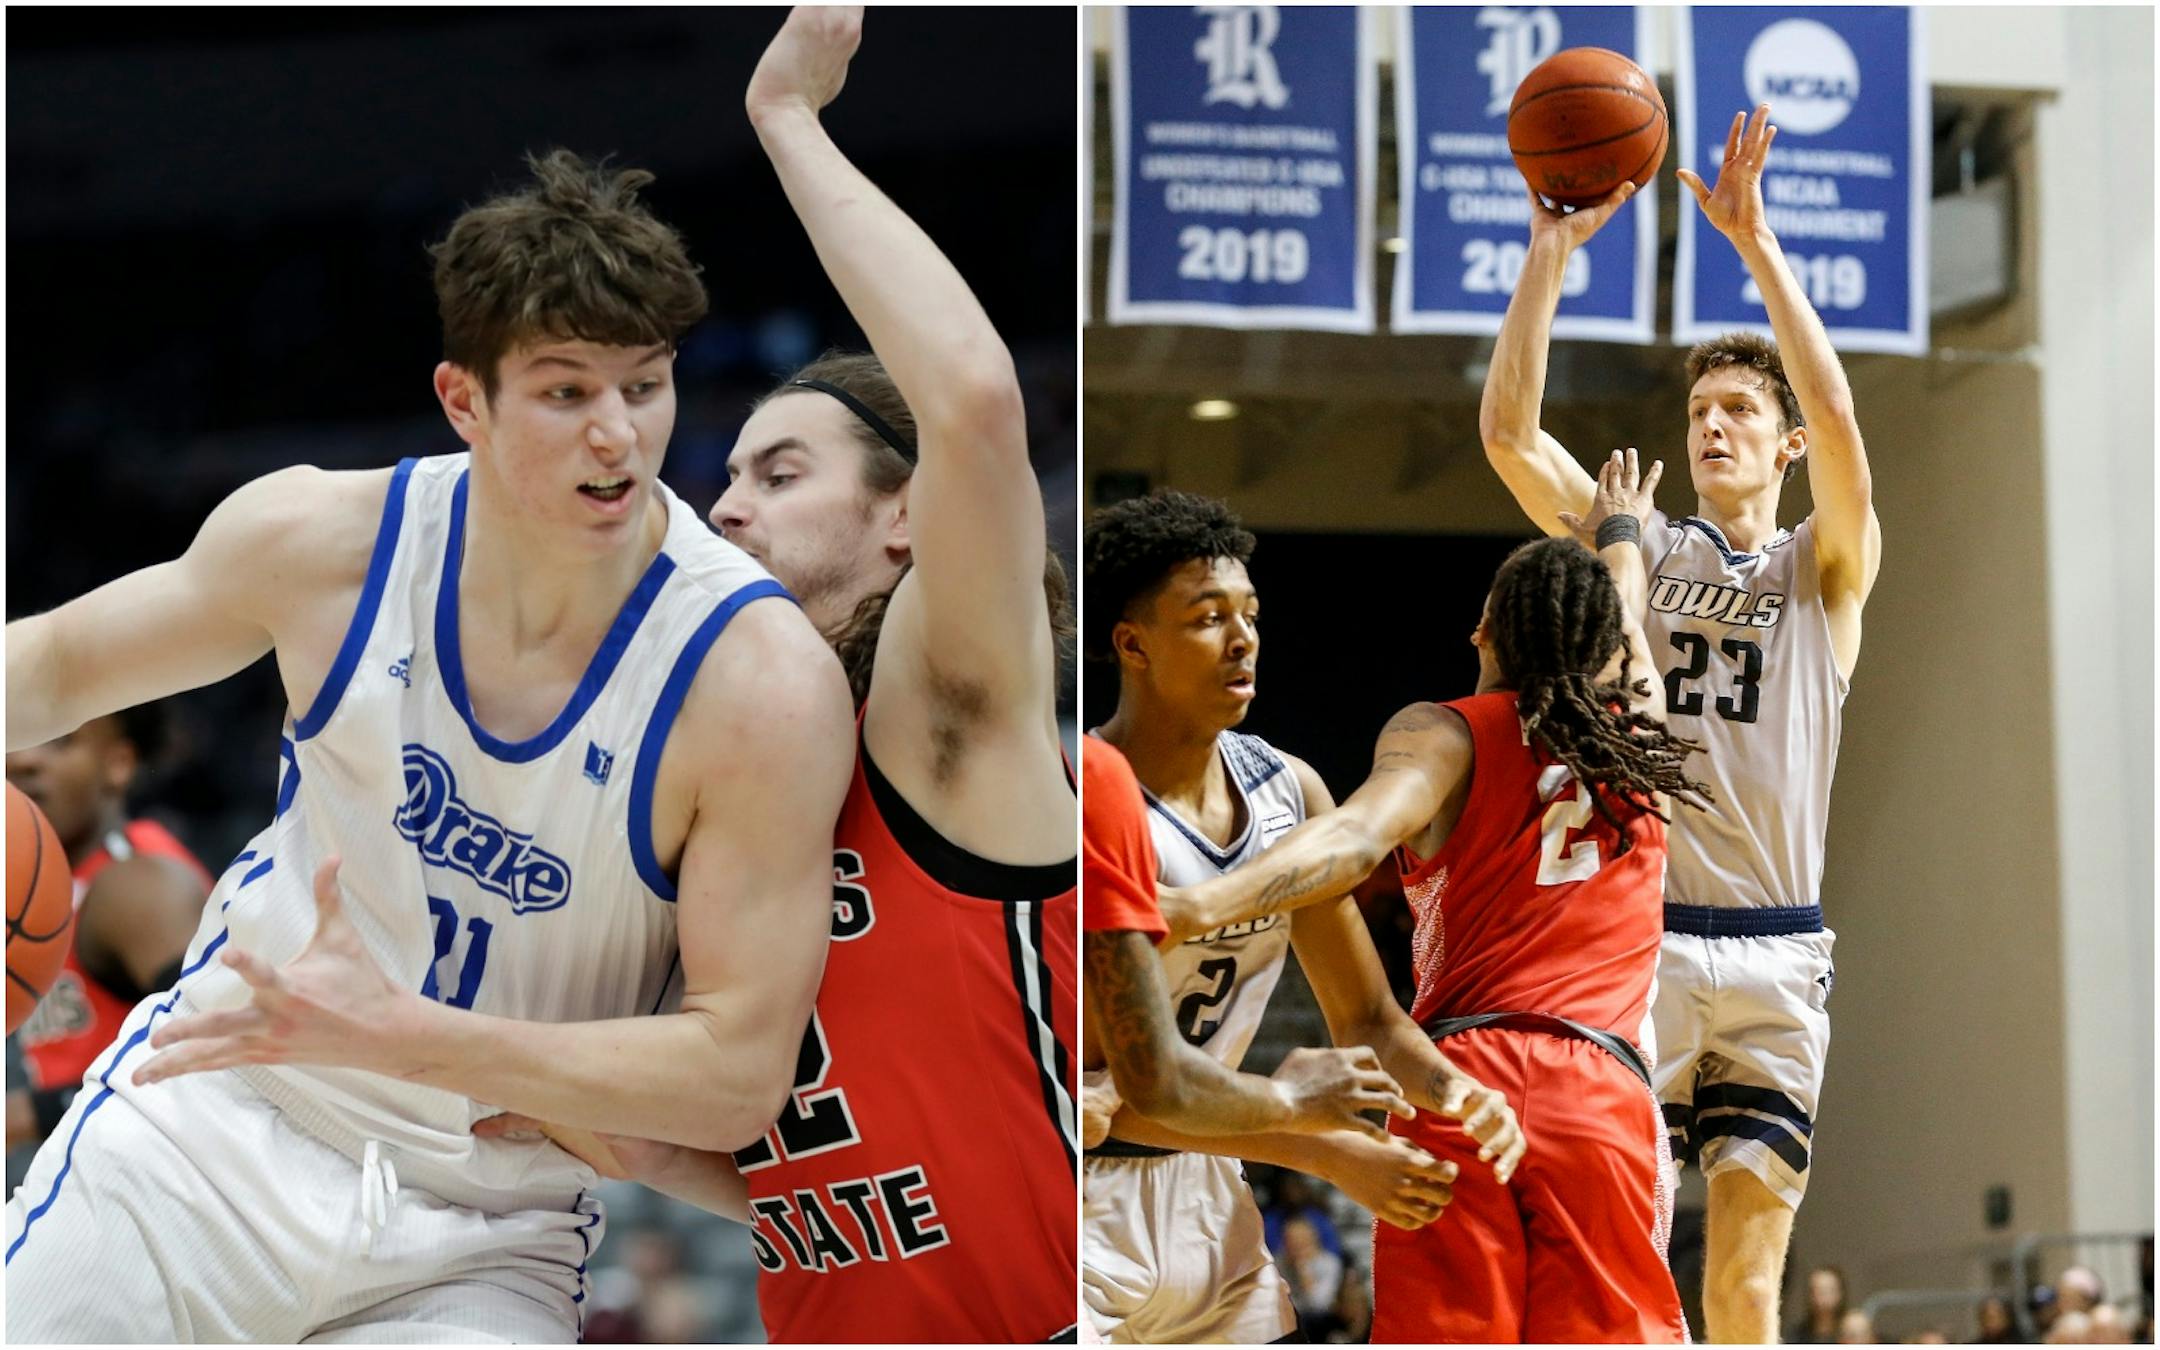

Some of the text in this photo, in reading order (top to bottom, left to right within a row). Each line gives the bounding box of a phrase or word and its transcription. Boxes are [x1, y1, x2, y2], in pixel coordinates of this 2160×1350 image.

[1166, 185, 1322, 216] CHAMPIONS
[1178, 225, 1310, 284] 2019
[1461, 238, 1592, 297] 209
[1650, 576, 1785, 628] OWLS
[1664, 632, 1763, 723] 23
[393, 744, 571, 915] Drake
[1535, 764, 1600, 886] 2
[1177, 955, 1237, 1047] 2
[750, 1164, 950, 1273] STATE
